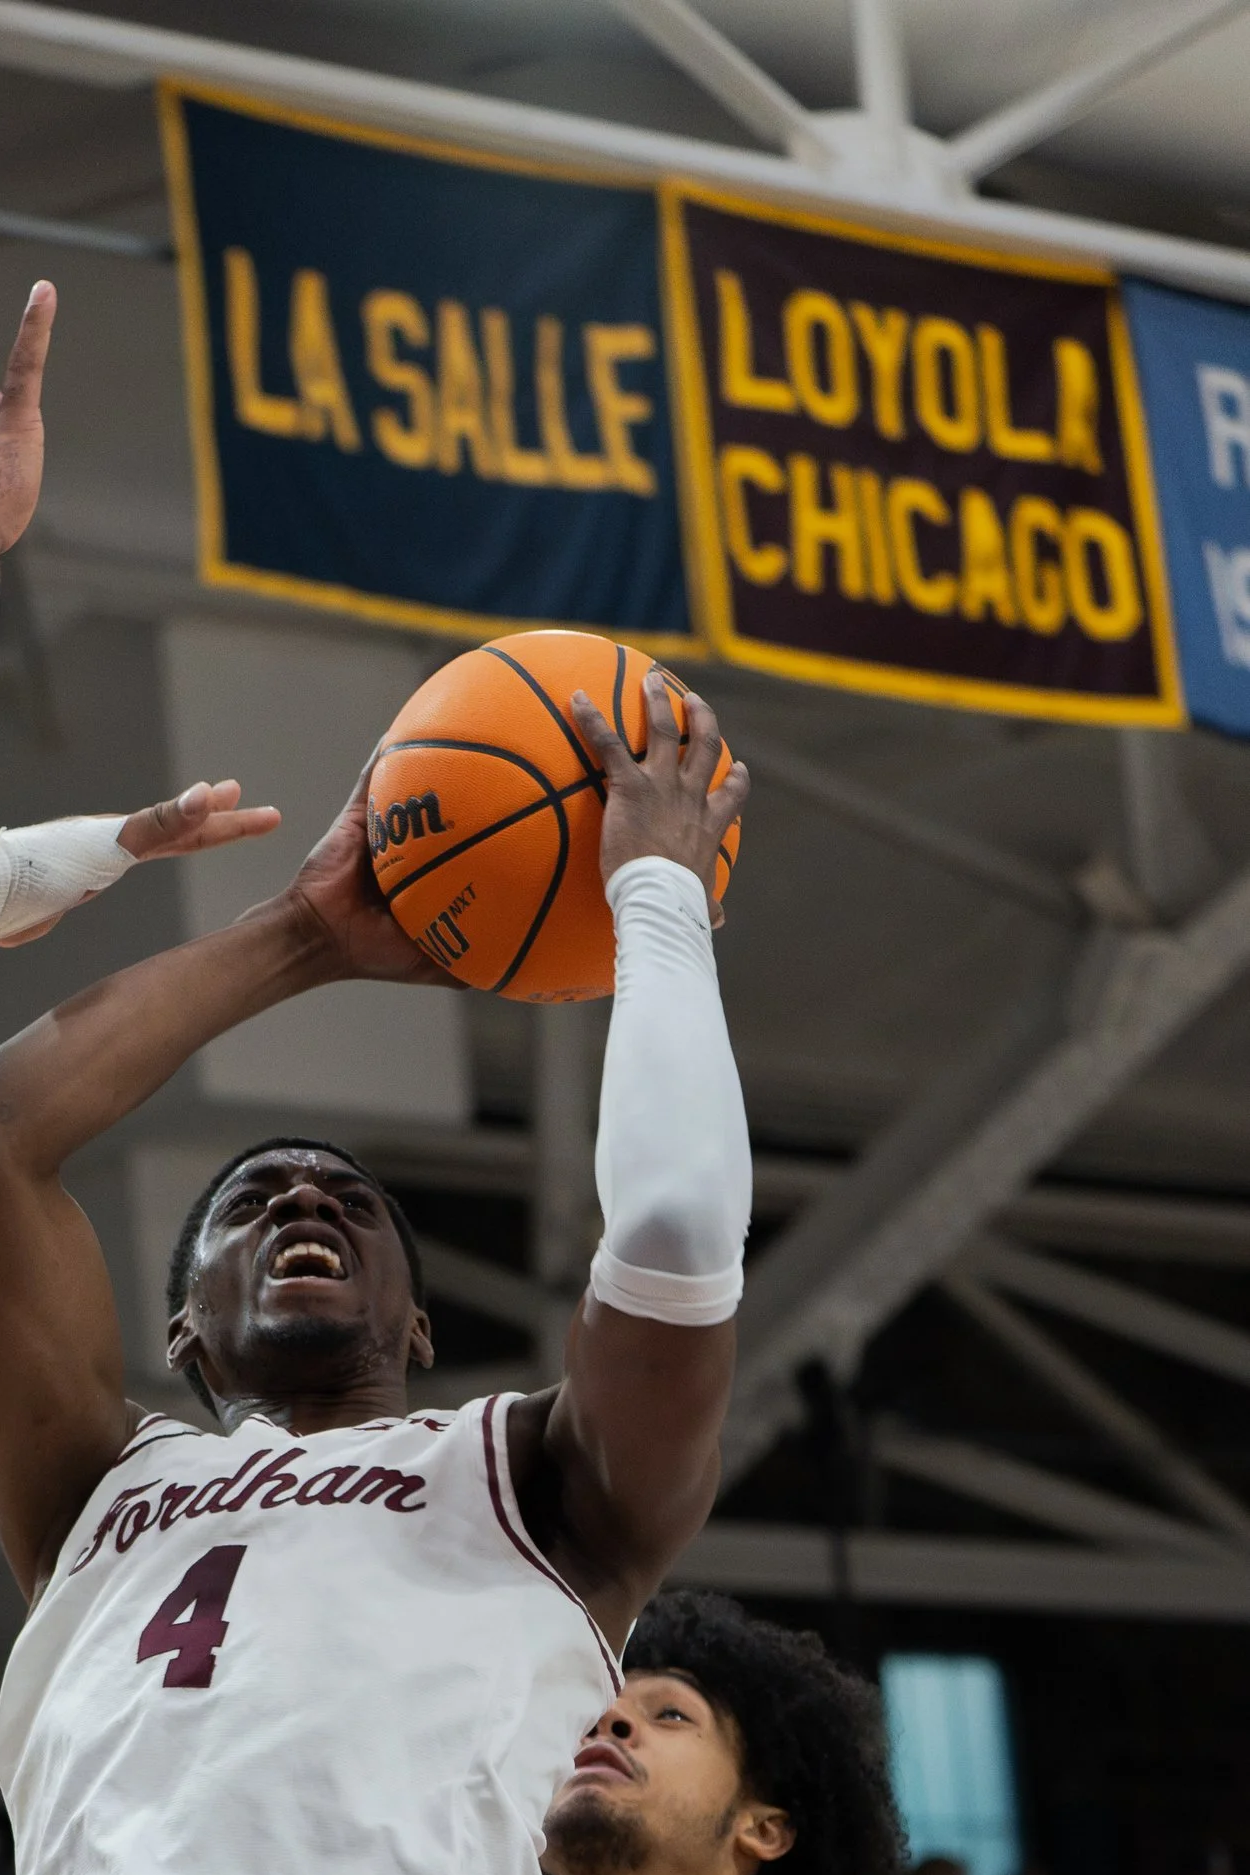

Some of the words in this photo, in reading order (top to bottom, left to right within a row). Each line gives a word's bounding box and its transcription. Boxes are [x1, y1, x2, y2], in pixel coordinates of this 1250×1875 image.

[223, 246, 364, 454] LA
[359, 287, 657, 498] SALLE
[714, 267, 1105, 477] LOYOLA
[715, 443, 1143, 642] CHICAGO
[69, 1447, 427, 1576] Fordham
[136, 1544, 248, 1689] 4
